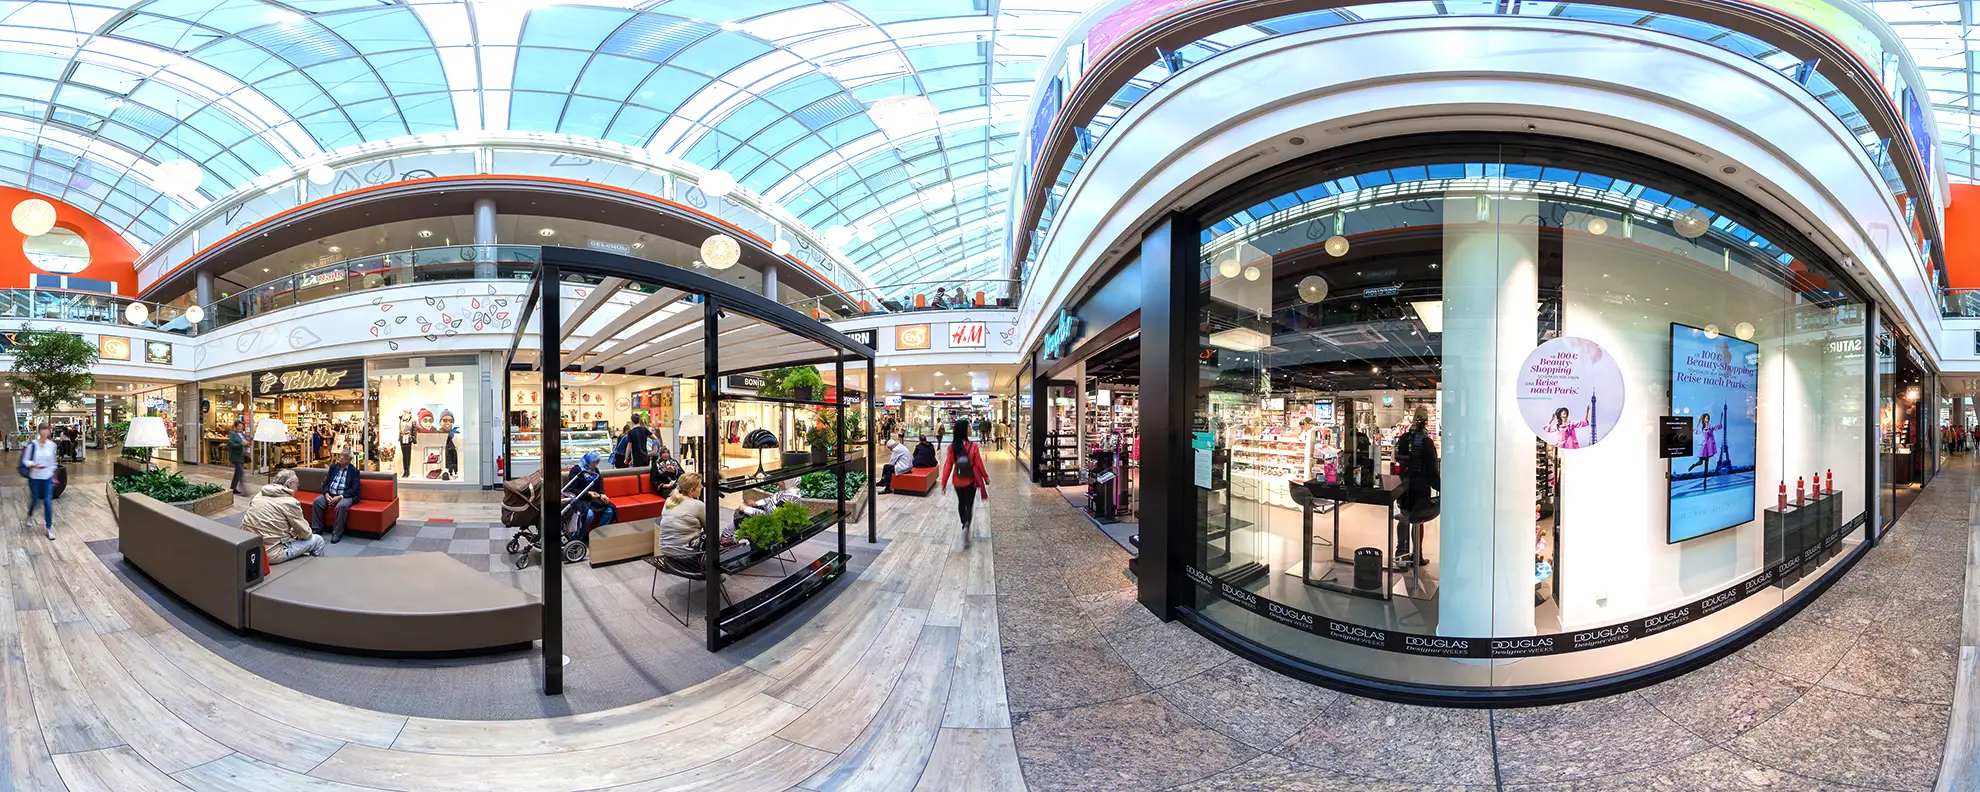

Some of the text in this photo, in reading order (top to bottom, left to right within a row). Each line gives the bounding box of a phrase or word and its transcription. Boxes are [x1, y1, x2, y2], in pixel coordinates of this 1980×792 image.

[951, 325, 983, 345] H&M
[1540, 358, 1572, 367] Beauty-
[1701, 350, 1715, 359] 100
[1530, 365, 1572, 375] Shopping
[280, 368, 348, 391] Tchibo
[1677, 371, 1702, 384] Reise
[1703, 376, 1725, 387] nach
[1804, 543, 1822, 558] DOUGLAS
[1779, 555, 1800, 573] DOUGLAS
[1745, 571, 1773, 590] DOUGLAS
[1222, 583, 1257, 605] DOUGLAS
[1701, 588, 1737, 609] DOUGLAS
[1269, 603, 1314, 625] DOUGLAS
[1644, 607, 1690, 628] DOUGLAS
[1330, 622, 1385, 641] DOUGLAS
[1330, 631, 1385, 647] Designer WEEKS
[1574, 624, 1629, 643] DOUGLAS
[1406, 636, 1469, 649] DOUGLAS
[1406, 645, 1442, 653] Designer
[1491, 637, 1554, 649] DOUGLAS
[1574, 634, 1629, 648] Designer WEEKS
[1491, 646, 1554, 656] Designer WEEKS
